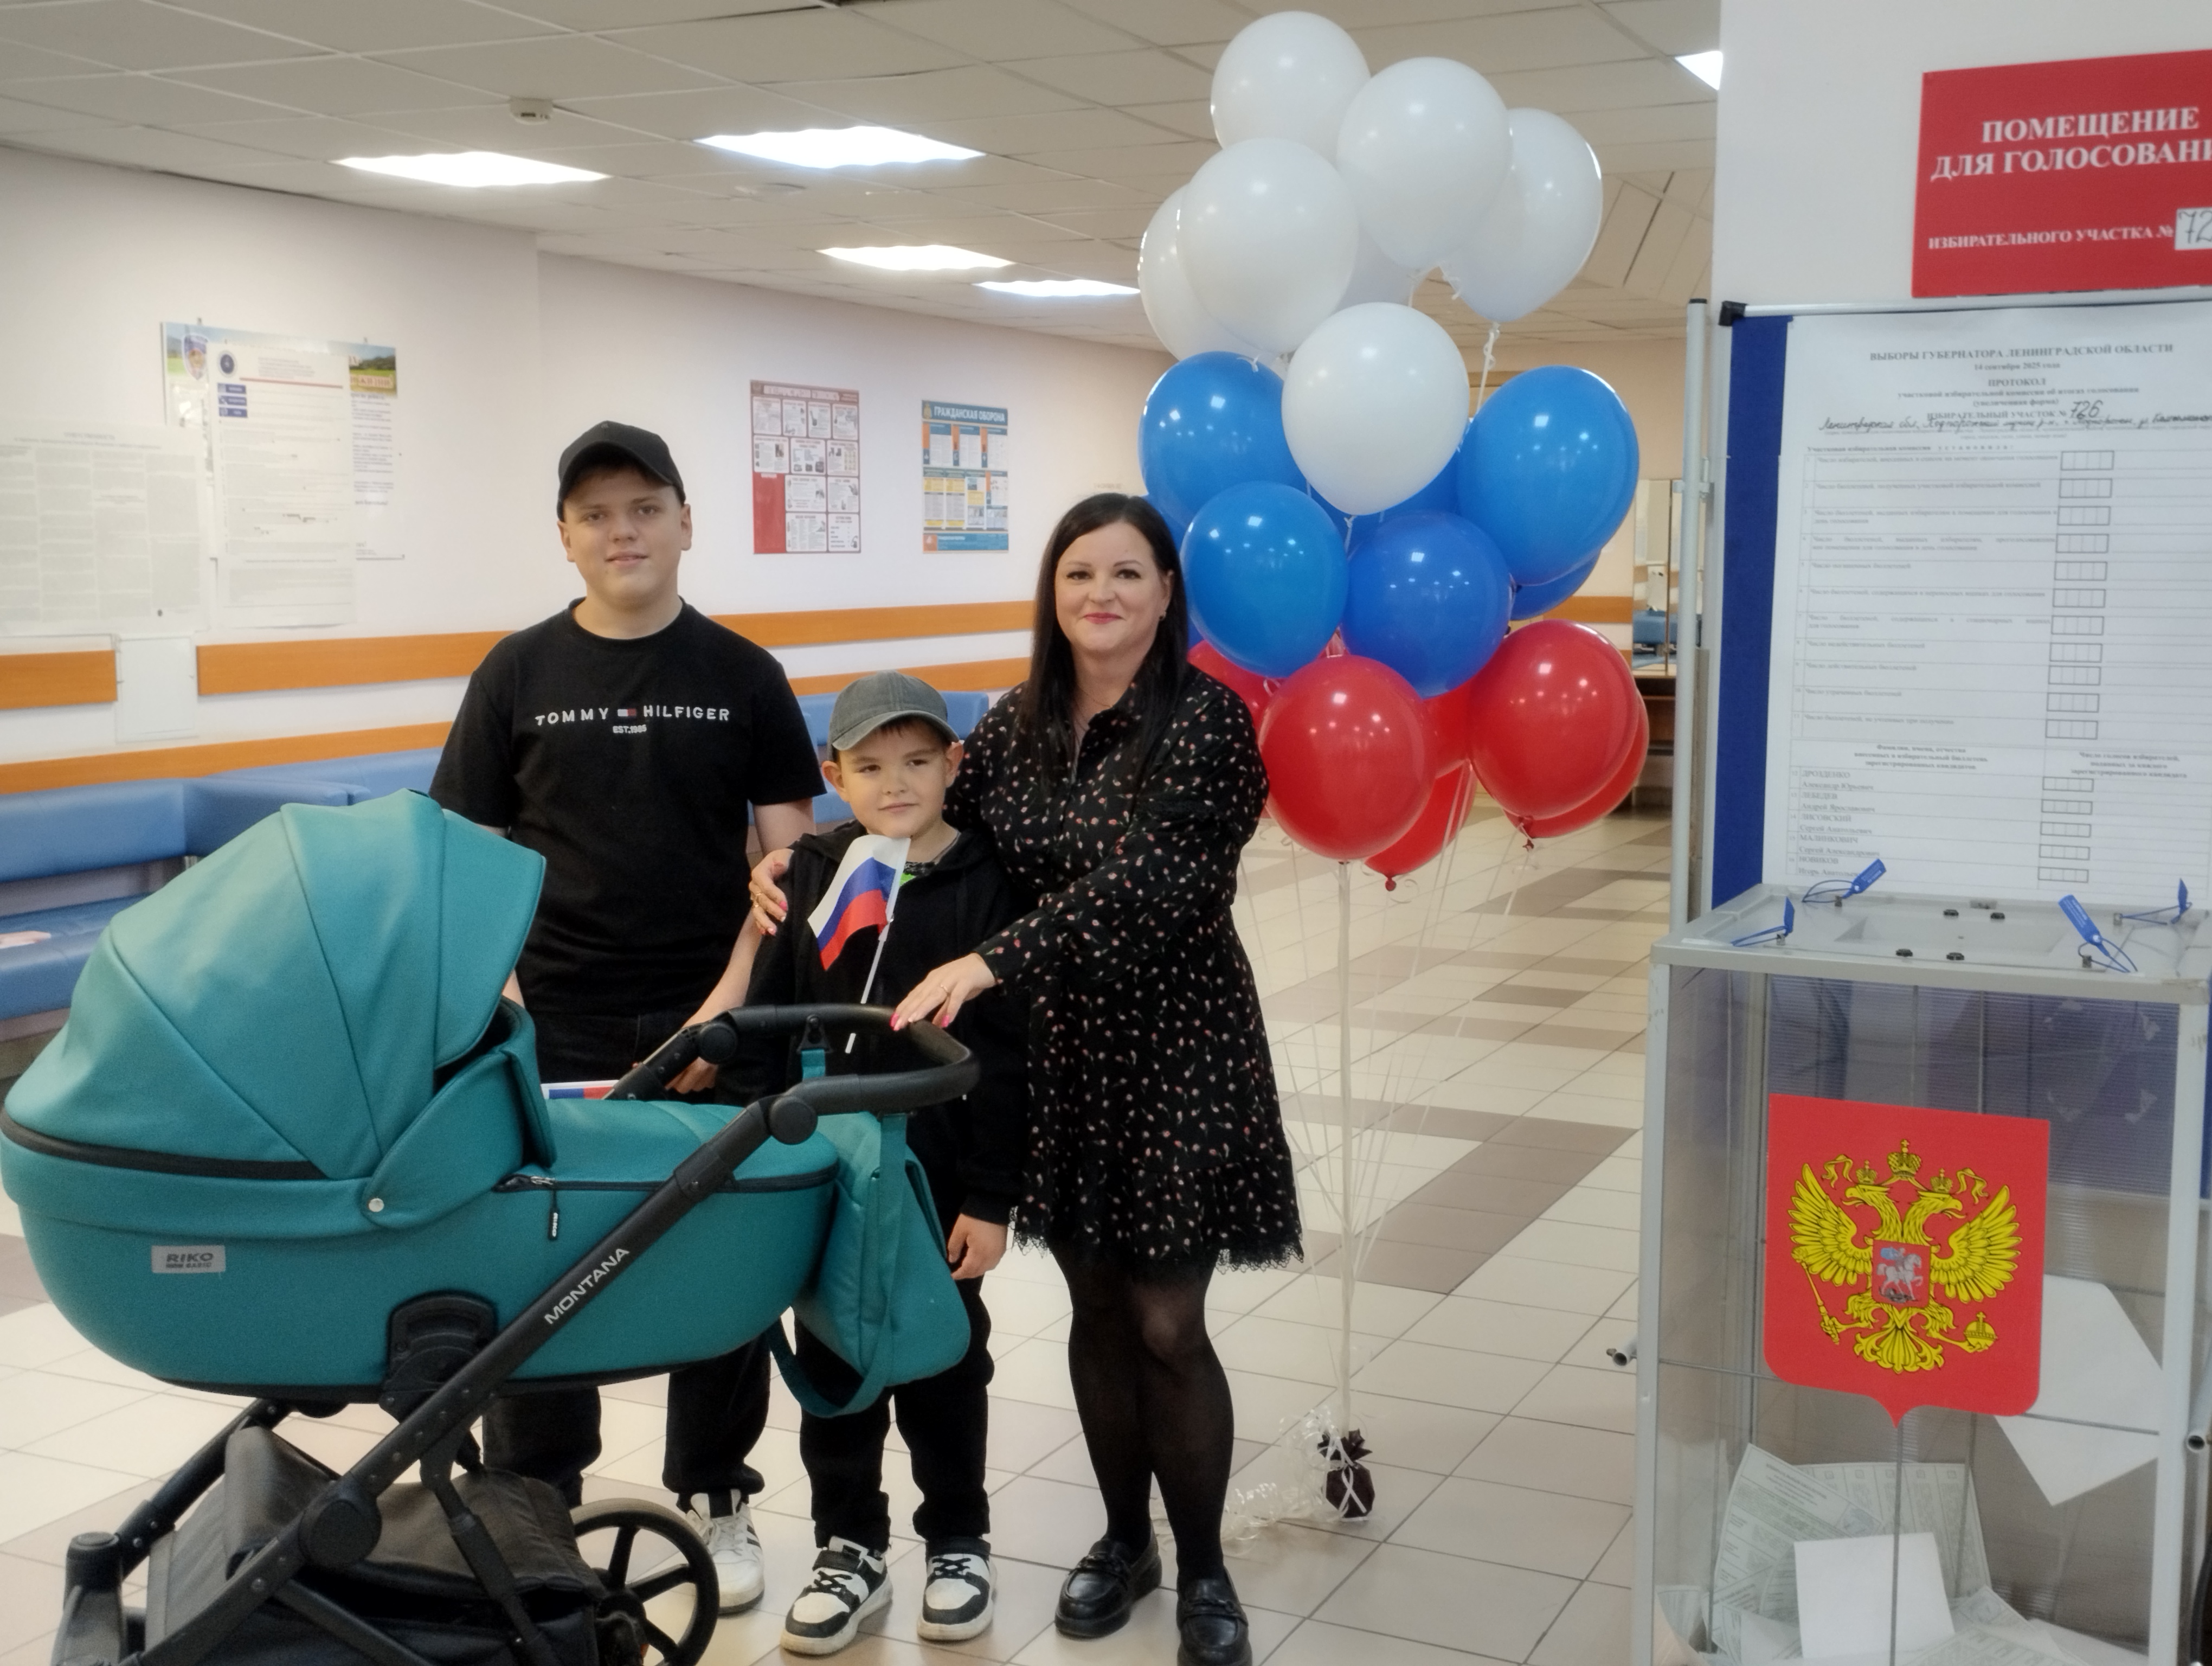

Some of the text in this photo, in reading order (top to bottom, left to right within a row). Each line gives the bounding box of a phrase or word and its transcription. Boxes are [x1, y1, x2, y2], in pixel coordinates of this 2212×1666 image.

[1982, 106, 2200, 143] ПОМЕЩЕНИЕ
[1930, 153, 1994, 182] ДЛЯ
[1928, 230, 2072, 249] ИЗБИРАТЕЛЬНОГО
[2075, 226, 2152, 242] УЧАСТКА
[2156, 225, 2174, 238] №
[1870, 344, 2174, 361] ВЫБОРЫ ГУБЕРНАТОРА ЛЕНИНГРАДСКОЙ ОБЛАСТИ
[1988, 378, 2046, 387] ПРОТОКОЛ
[934, 406, 1006, 422] ГРАЖДАНСКАЯ ОБОРОНА
[1927, 411, 2008, 420] ИЗБИРАТЕЛЬНЫЙ
[2010, 409, 2055, 418] УЧАСТОК
[2070, 399, 2104, 420] 726
[535, 704, 730, 726] TOMMY HILFIGER
[166, 1252, 214, 1263] RIKO
[544, 1248, 631, 1325] MONTANA
